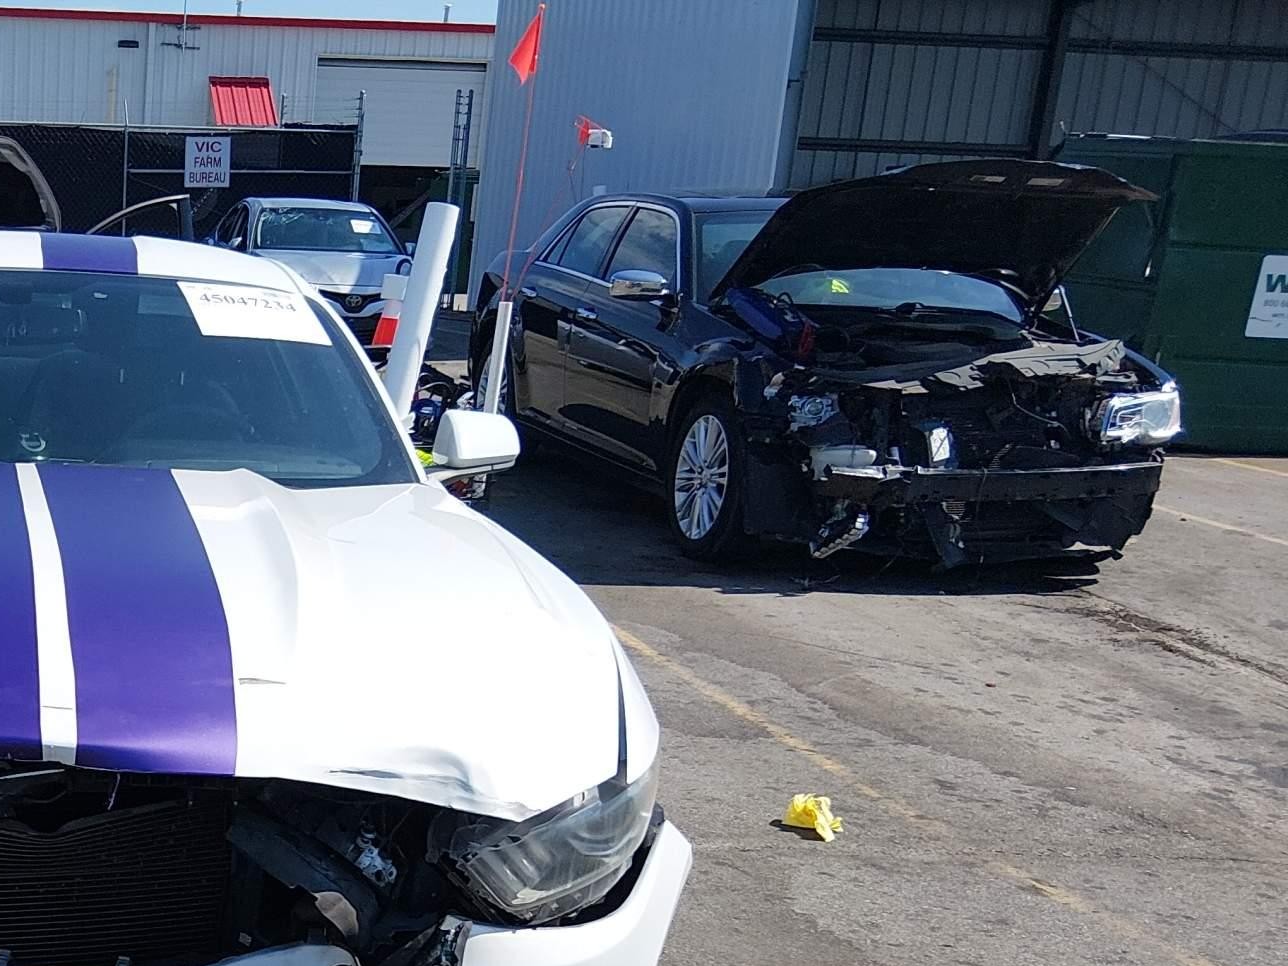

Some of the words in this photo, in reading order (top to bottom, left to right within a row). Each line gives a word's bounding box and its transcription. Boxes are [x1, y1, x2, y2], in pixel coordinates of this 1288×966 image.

[195, 141, 222, 153] VIC
[194, 156, 222, 169] FARM
[189, 171, 226, 184] BUREAU
